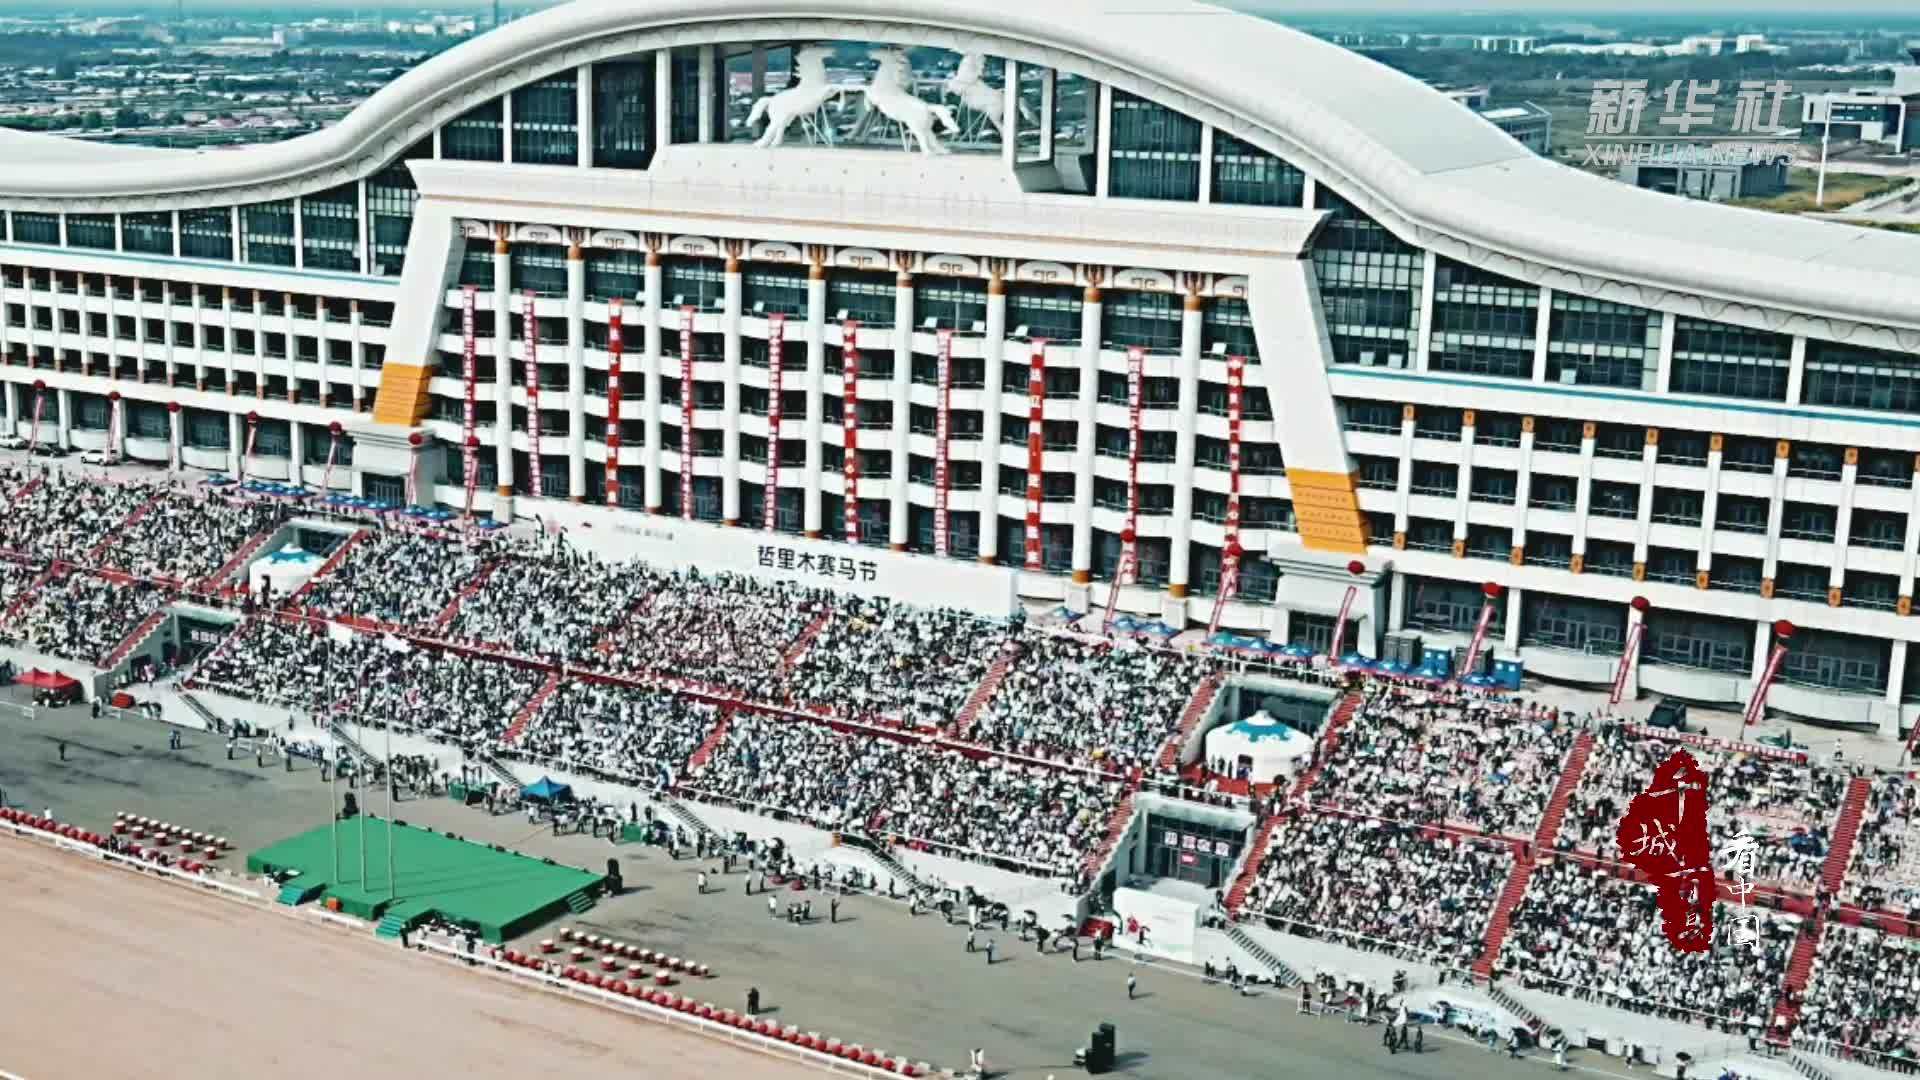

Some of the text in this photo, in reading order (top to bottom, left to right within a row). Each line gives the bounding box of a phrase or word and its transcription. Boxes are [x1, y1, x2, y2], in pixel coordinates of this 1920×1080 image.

[758, 545, 878, 582] 哲里木赛马节
